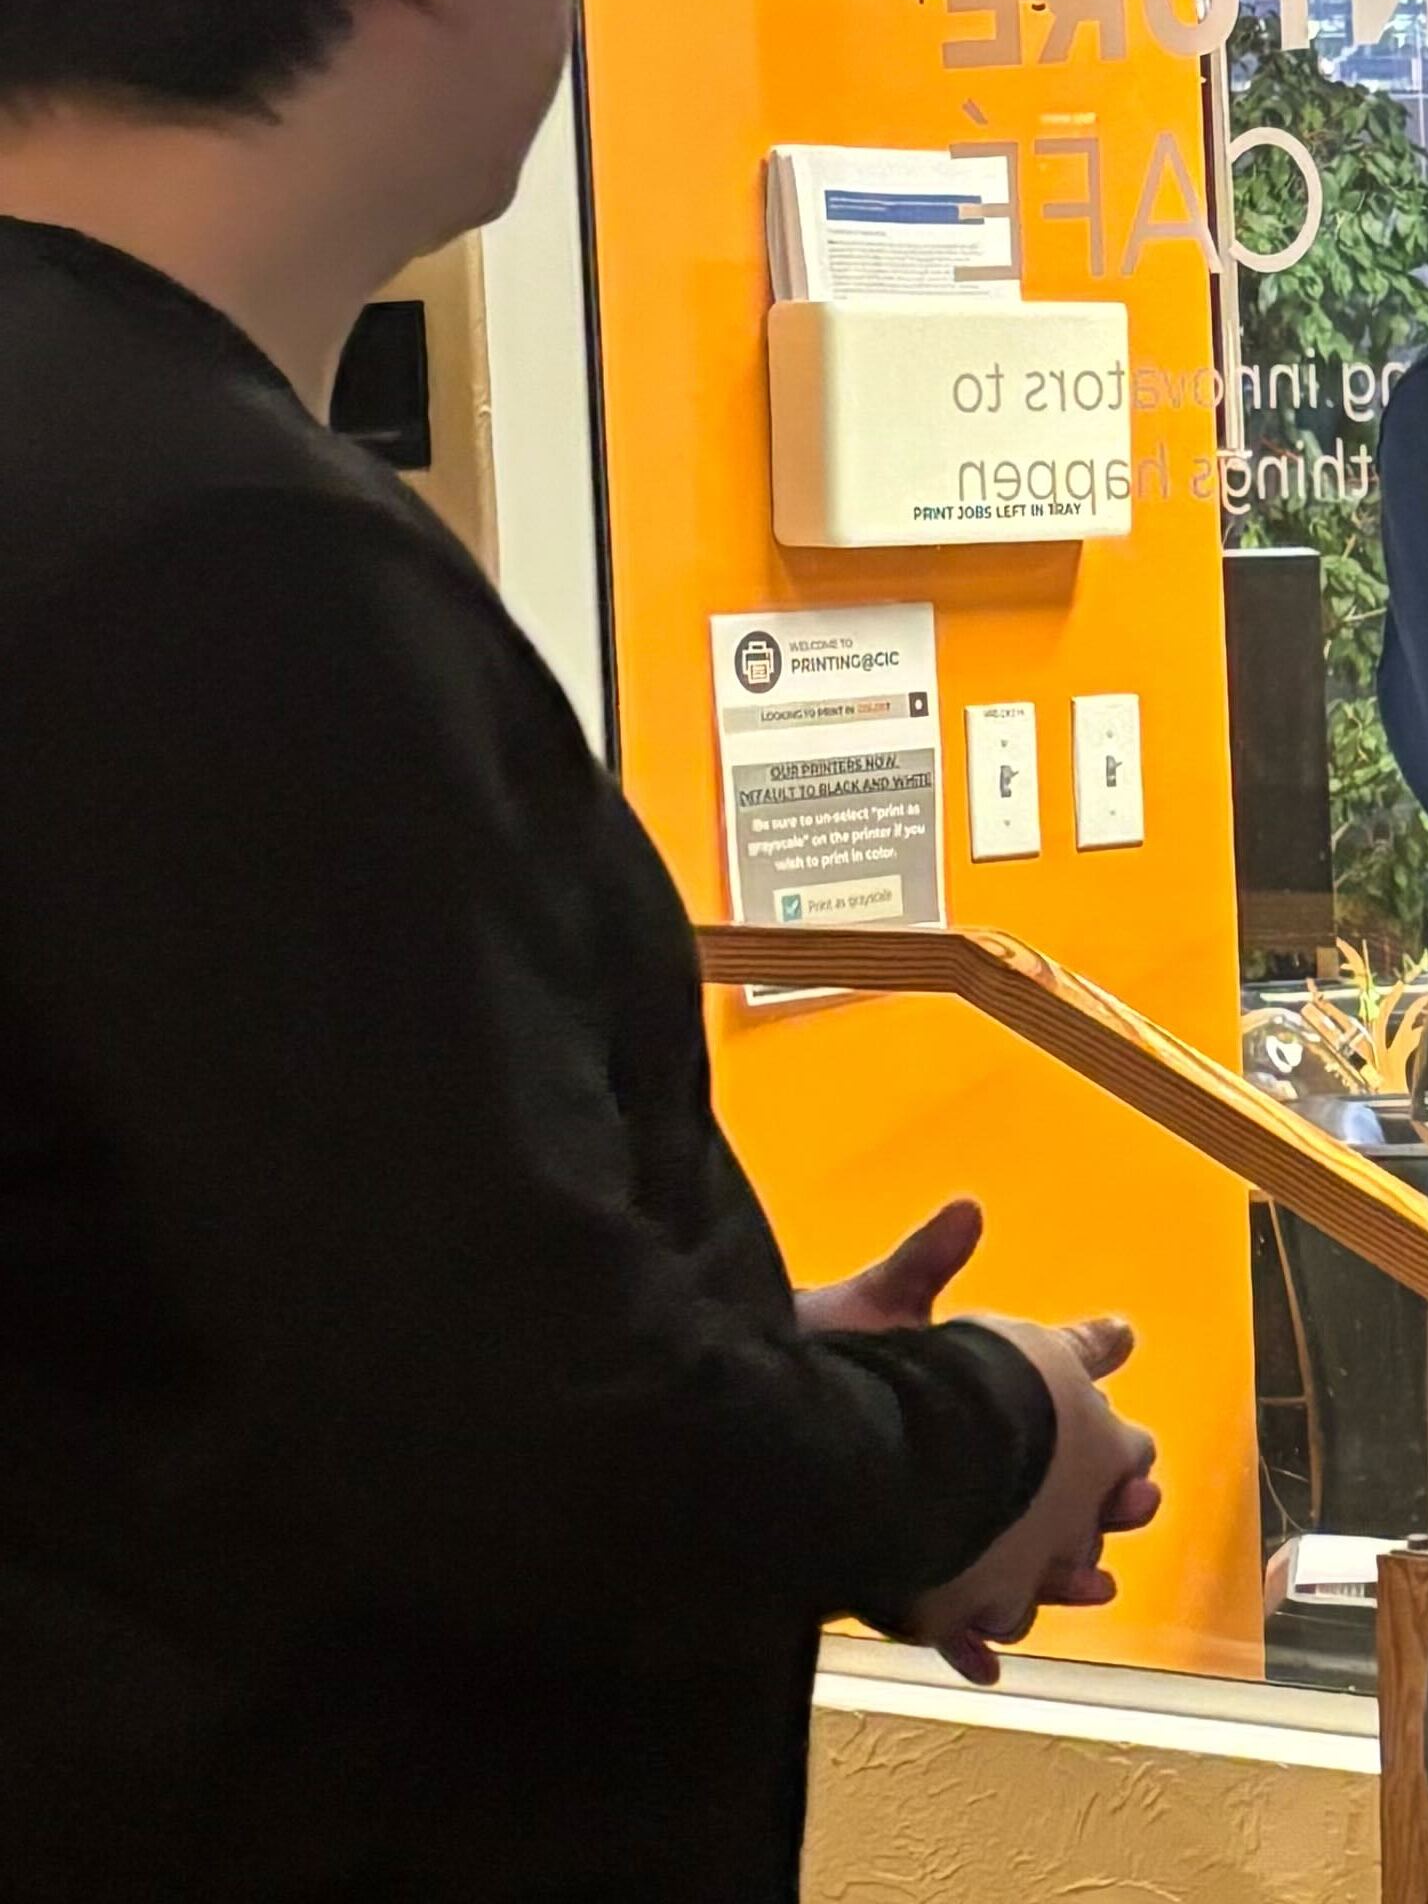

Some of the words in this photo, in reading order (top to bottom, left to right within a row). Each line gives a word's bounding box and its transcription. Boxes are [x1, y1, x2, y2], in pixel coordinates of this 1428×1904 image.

[913, 506, 954, 521] PRINT
[957, 505, 992, 520] JOBS
[995, 504, 1026, 518] LEFT
[1030, 504, 1044, 517] IN
[1048, 502, 1082, 516] TRAY
[791, 651, 899, 673] PRINTING@CIC
[771, 765, 799, 780] OUR
[802, 758, 862, 776] PRINTERS
[800, 784, 815, 798] TO
[819, 780, 860, 796] BLACK
[863, 776, 890, 790] AND
[772, 817, 798, 830] sure
[801, 815, 813, 826] to
[812, 835, 827, 846] on
[829, 830, 849, 843] the
[852, 827, 891, 844] printer
[904, 824, 926, 839] you
[806, 855, 819, 867] to
[821, 851, 849, 869] print
[851, 848, 863, 862] in
